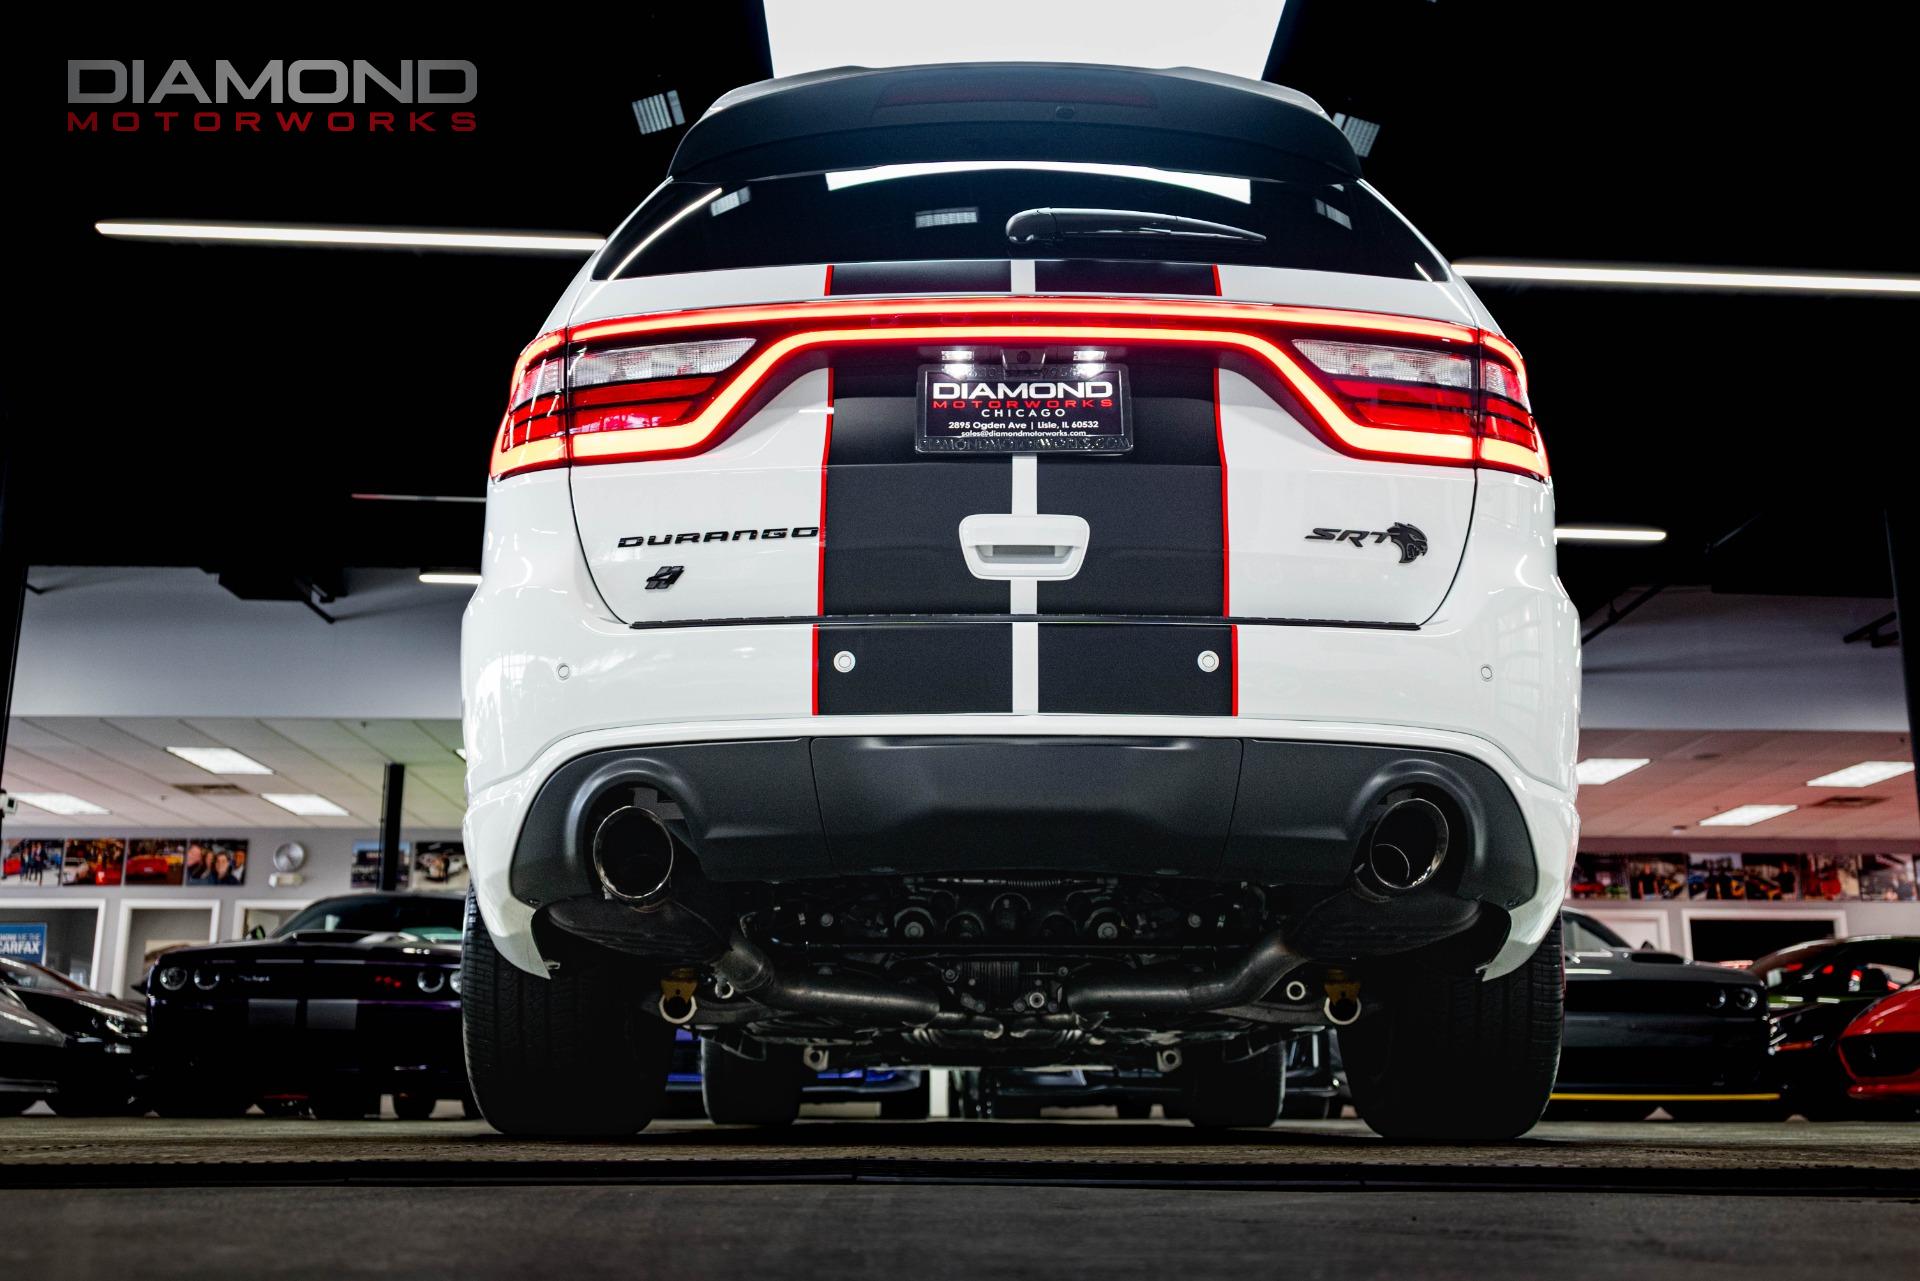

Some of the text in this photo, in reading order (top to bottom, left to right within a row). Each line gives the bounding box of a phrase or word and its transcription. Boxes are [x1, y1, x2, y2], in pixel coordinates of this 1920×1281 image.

[932, 381, 1113, 400] DIAMOND
[932, 399, 1113, 410] MOTORWORKS
[981, 408, 1066, 418] CHICAGO
[948, 421, 970, 430] 2895
[972, 421, 1006, 431] Ogden
[1008, 421, 1027, 430] Ave
[1037, 421, 1060, 430] Lisle,
[1061, 420, 1070, 429] IL
[1071, 420, 1099, 429] 60532
[960, 429, 1087, 438] sales@diamondmotorworks.com
[617, 526, 819, 548] DURANGO
[1304, 527, 1400, 548] SRT
